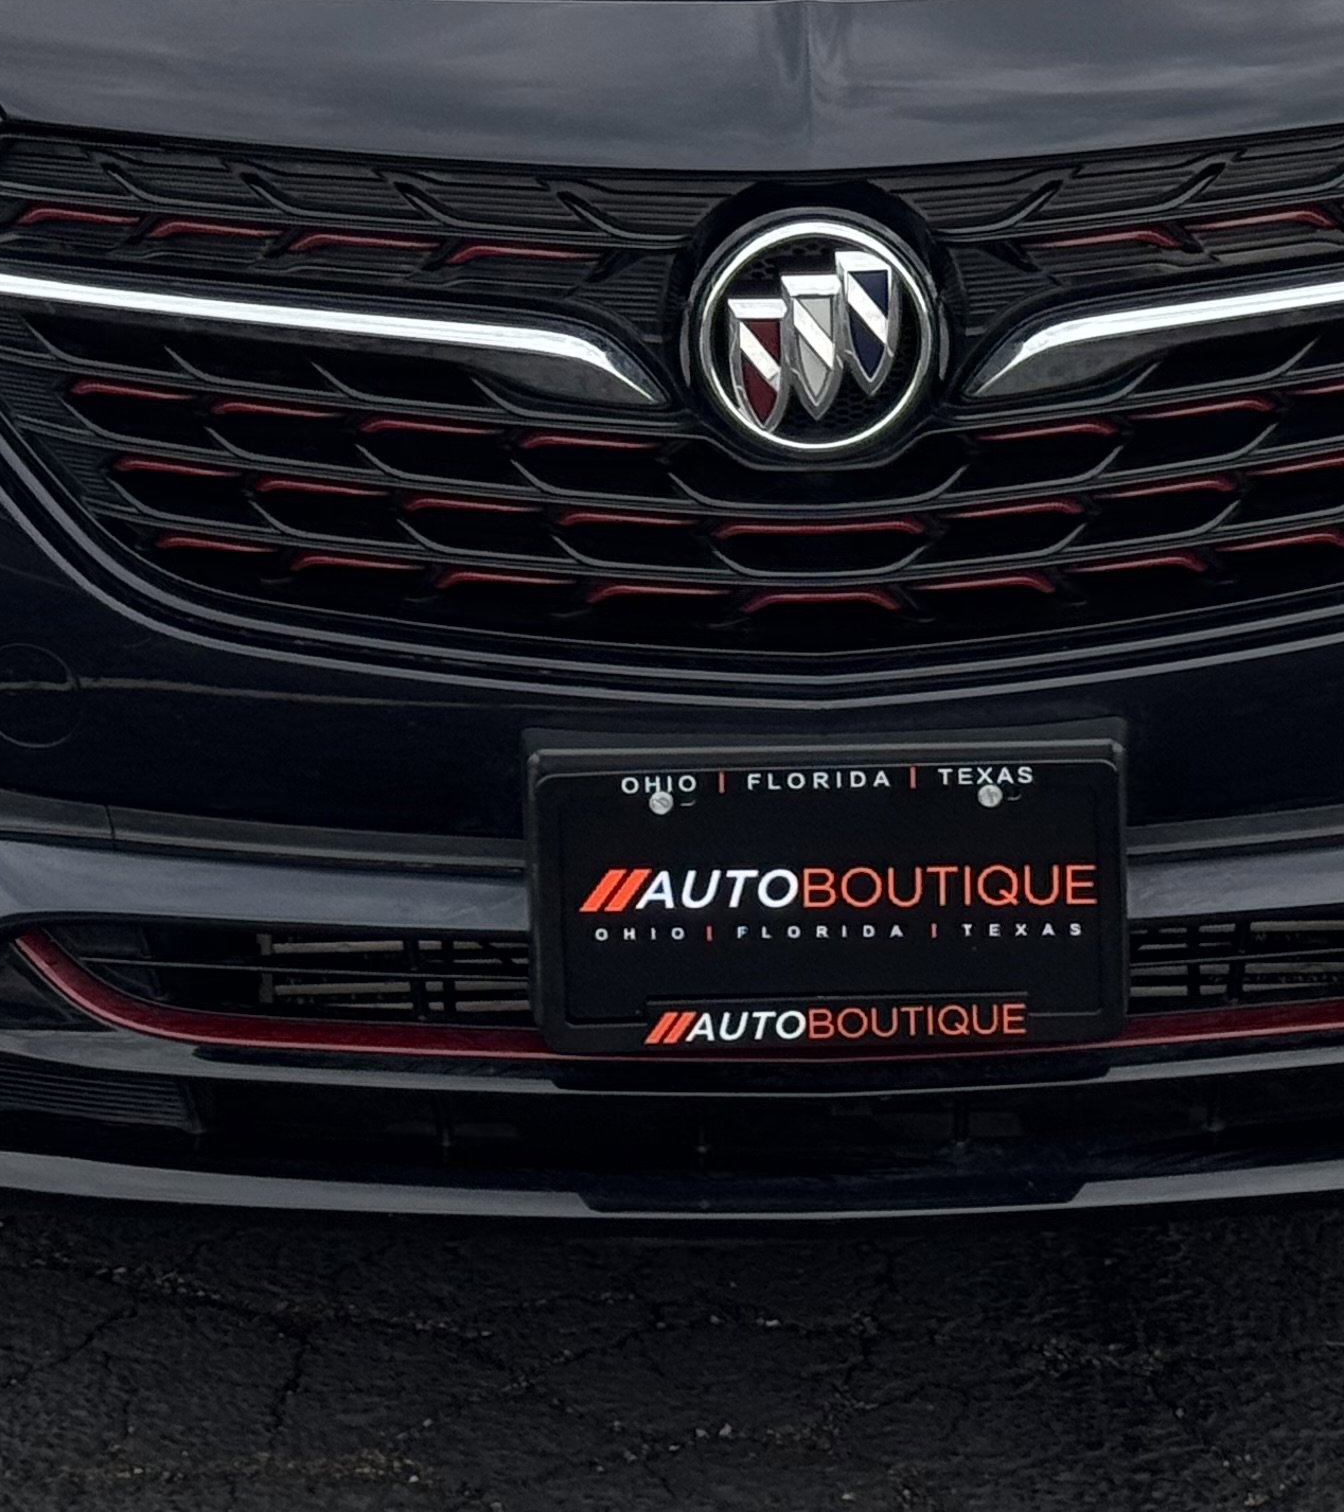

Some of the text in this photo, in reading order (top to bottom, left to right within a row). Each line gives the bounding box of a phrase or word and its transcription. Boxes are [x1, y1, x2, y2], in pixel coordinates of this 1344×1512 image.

[620, 766, 1034, 794] OHIO FLORIDA TEXAS
[636, 864, 1099, 910] AUTOBOUTIQUE
[595, 922, 1083, 942] OHIO FLORIDA TEXAS
[686, 1003, 1028, 1042] AUTOBOUTIQUE
